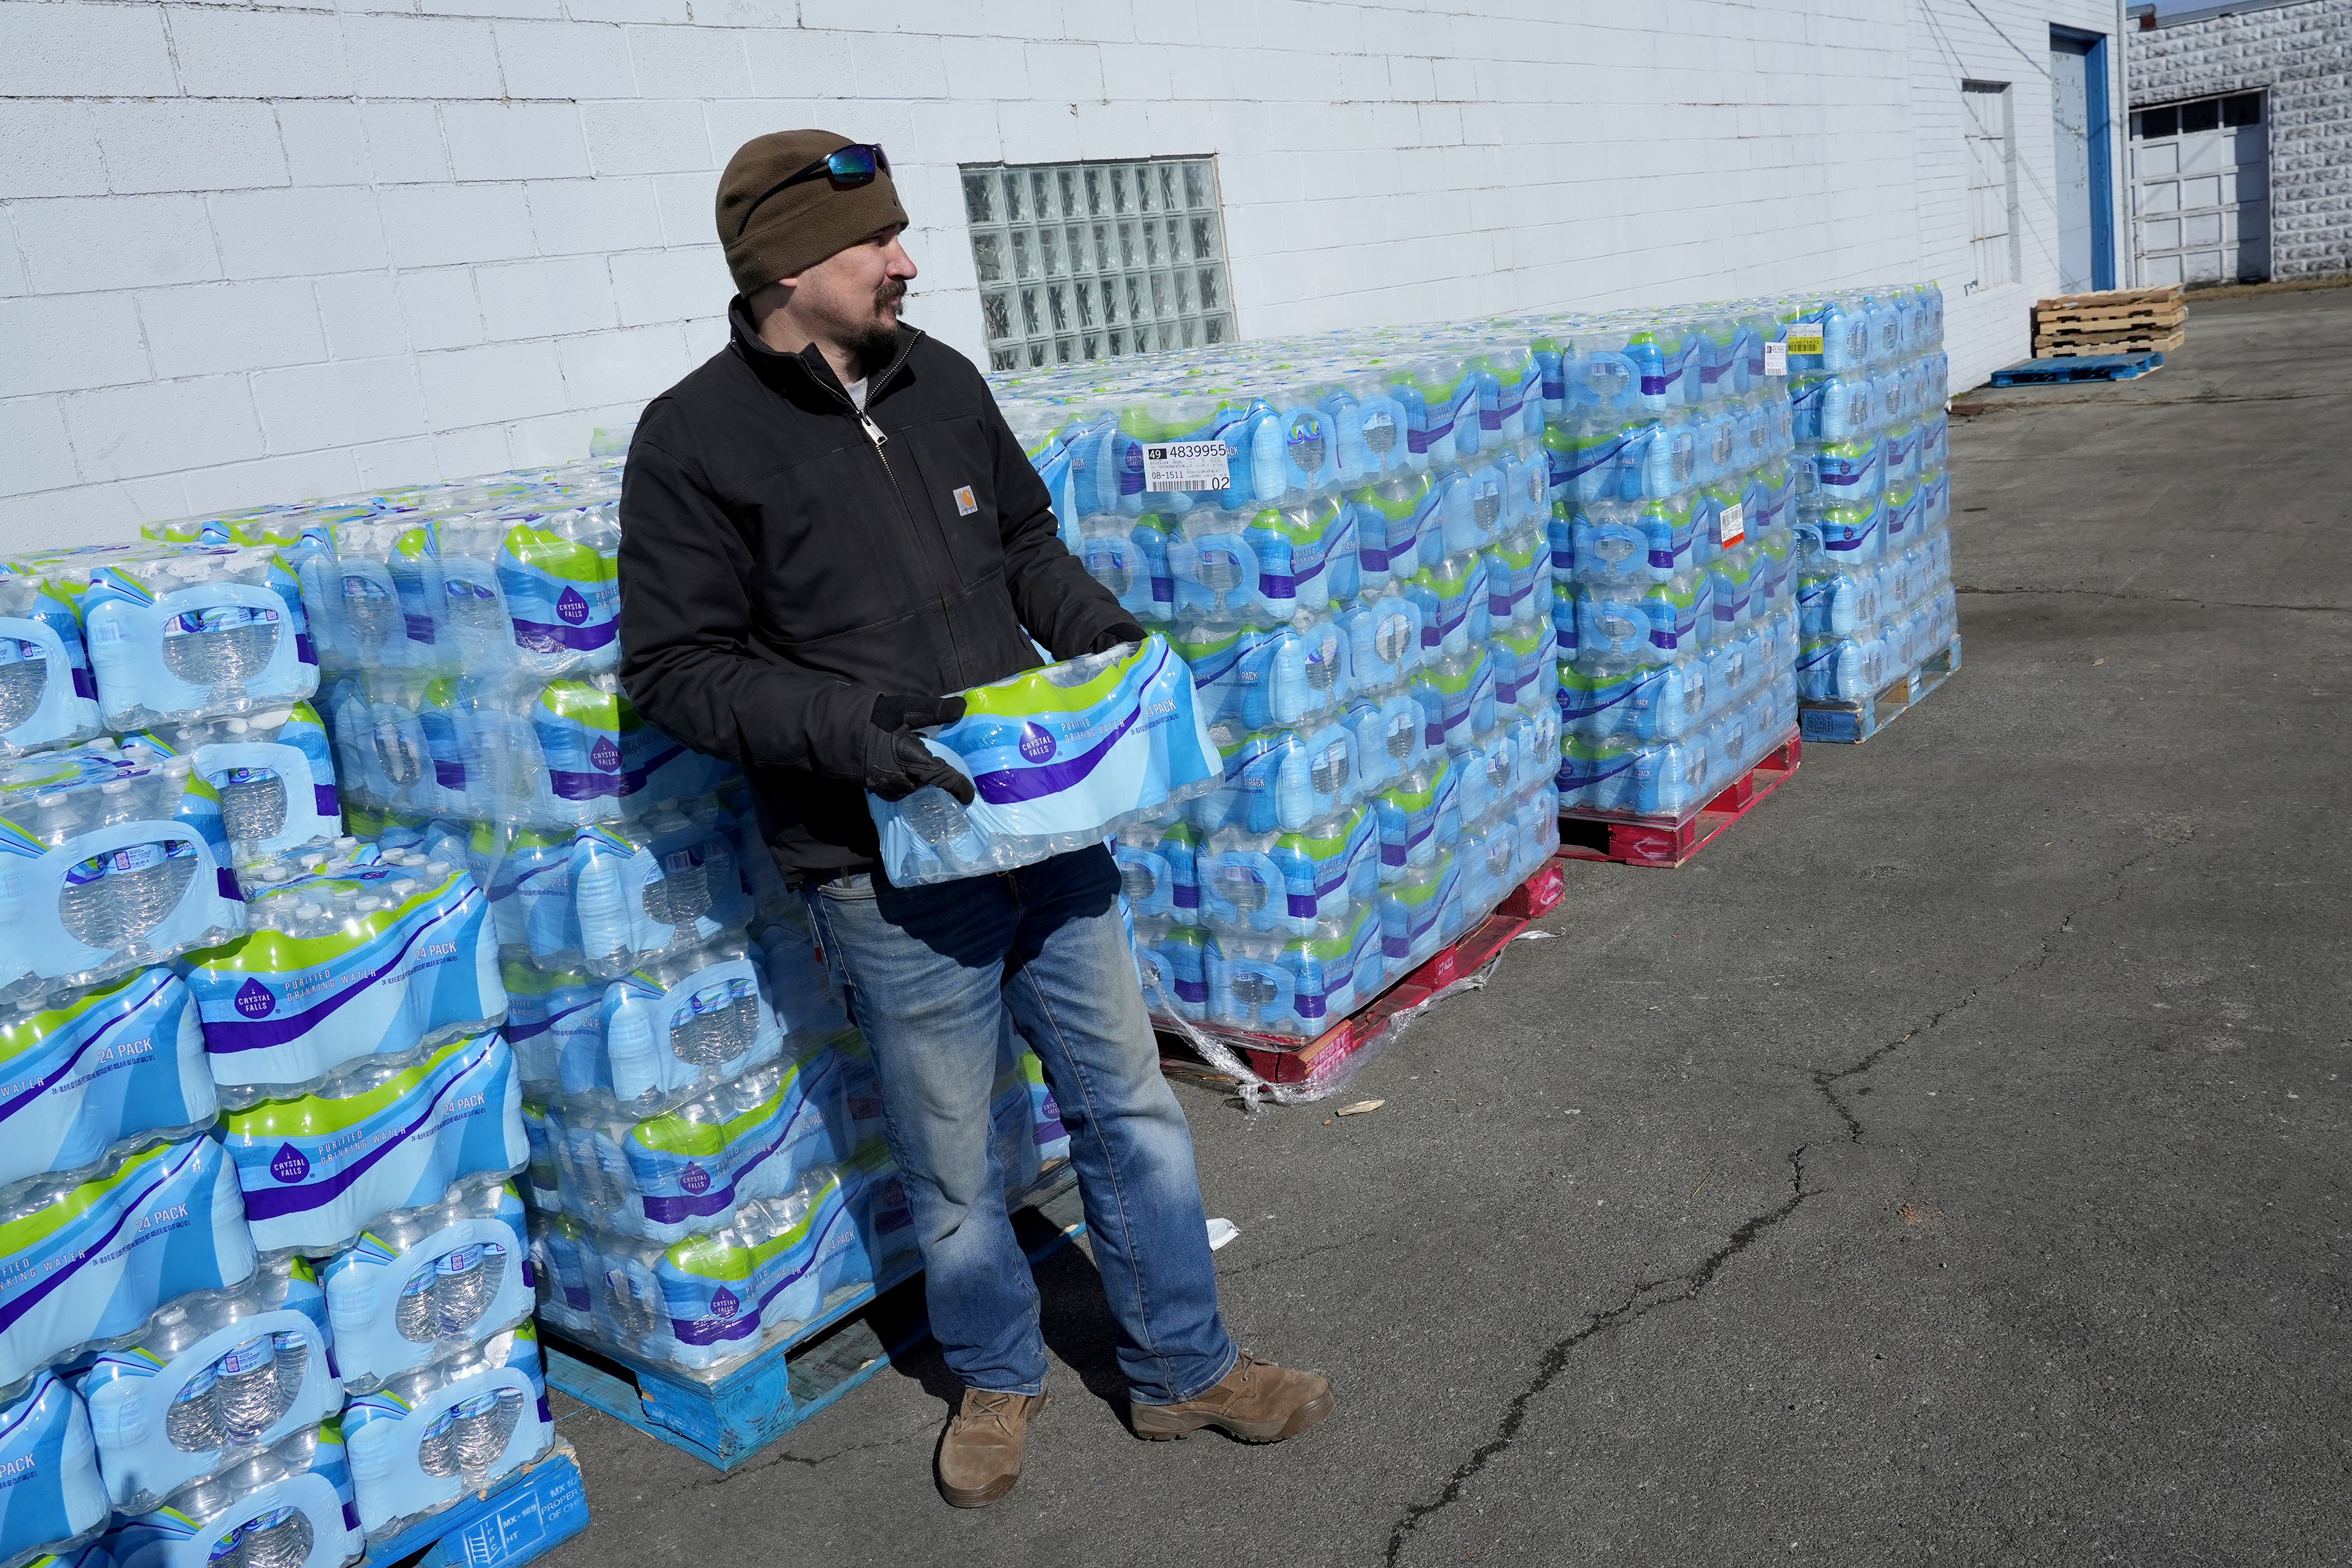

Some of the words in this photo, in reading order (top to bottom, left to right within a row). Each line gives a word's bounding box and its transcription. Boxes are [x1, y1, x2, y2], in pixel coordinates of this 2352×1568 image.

[1149, 449, 1161, 459] 49
[1170, 444, 1227, 458] 4839955
[1622, 457, 1636, 465] PACK
[1152, 471, 1184, 480] 08-1511
[1212, 477, 1230, 491] 02
[1342, 541, 1350, 551] 24
[559, 602, 585, 611] CRYSTAL
[564, 610, 583, 618] FALLS
[1242, 671, 1258, 681] PACK
[1155, 697, 1177, 715] PACK
[1060, 718, 1090, 732] PURIFIED
[1064, 727, 1097, 744] DRINKING
[1097, 717, 1125, 735] WATER
[1021, 736, 1052, 751] CRYSTAL
[593, 751, 619, 759] CRYSTAL
[1029, 745, 1049, 757] FALLS
[1249, 777, 1265, 787] PACK
[551, 877, 562, 888] 24
[415, 947, 427, 961] 24
[429, 940, 458, 957] PACK
[284, 969, 332, 991] PURIFIED
[286, 978, 336, 1003] DRINKING
[340, 968, 377, 985] WATER
[238, 994, 272, 1006] CRYSTAL
[245, 1002, 267, 1012] FALLS
[583, 1017, 593, 1027] 24
[98, 1047, 115, 1064] 24
[117, 1036, 154, 1058] PACK
[0, 1076, 44, 1097] WATER
[444, 1101, 455, 1116] 24
[457, 1091, 486, 1110] PACK
[800, 1121, 810, 1132] 24
[810, 1109, 828, 1126] PACK
[318, 1129, 364, 1156] PURIFIED
[321, 1138, 367, 1166] DRINKING
[373, 1125, 407, 1144] WATER
[746, 1144, 772, 1156] WATER
[274, 1159, 306, 1171] CRYSTAL
[280, 1167, 302, 1177] FALLS
[682, 1174, 708, 1184] CRYSTAL
[688, 1180, 706, 1189] FALLS
[136, 1218, 151, 1233] 24
[155, 1202, 190, 1225] PACK
[827, 1242, 836, 1253] 24
[837, 1230, 856, 1246] PACK
[1, 1258, 31, 1277] FIED
[44, 1249, 86, 1273] WATER
[775, 1266, 802, 1279] WATER
[713, 1299, 737, 1308] CRYSTAL
[0, 1451, 36, 1479] PACK
[550, 1483, 566, 1498] MX
[549, 1508, 562, 1521] OF
[506, 1531, 519, 1544] HT
